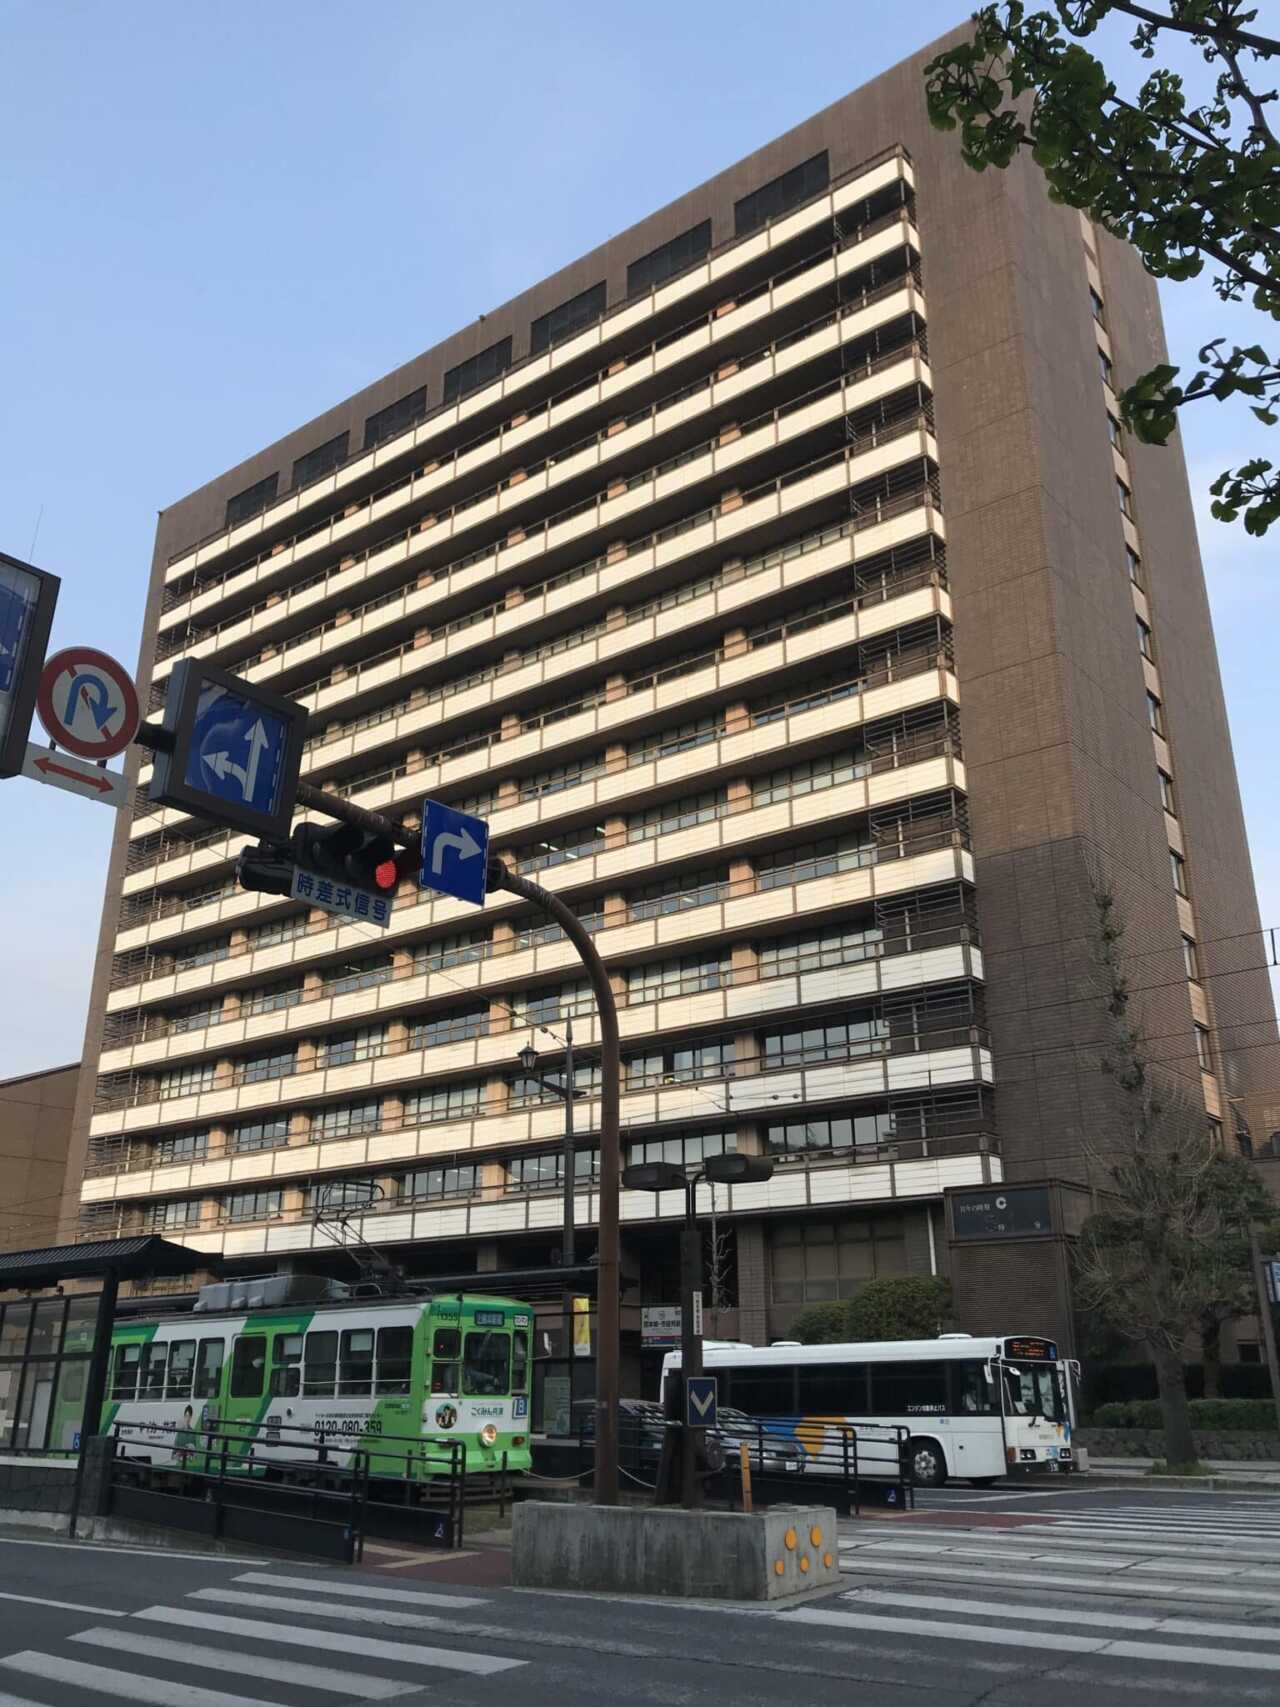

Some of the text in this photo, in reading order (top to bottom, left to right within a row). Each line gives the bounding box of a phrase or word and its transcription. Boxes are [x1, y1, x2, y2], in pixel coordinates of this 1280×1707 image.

[297, 872, 387, 921] 時差式信号
